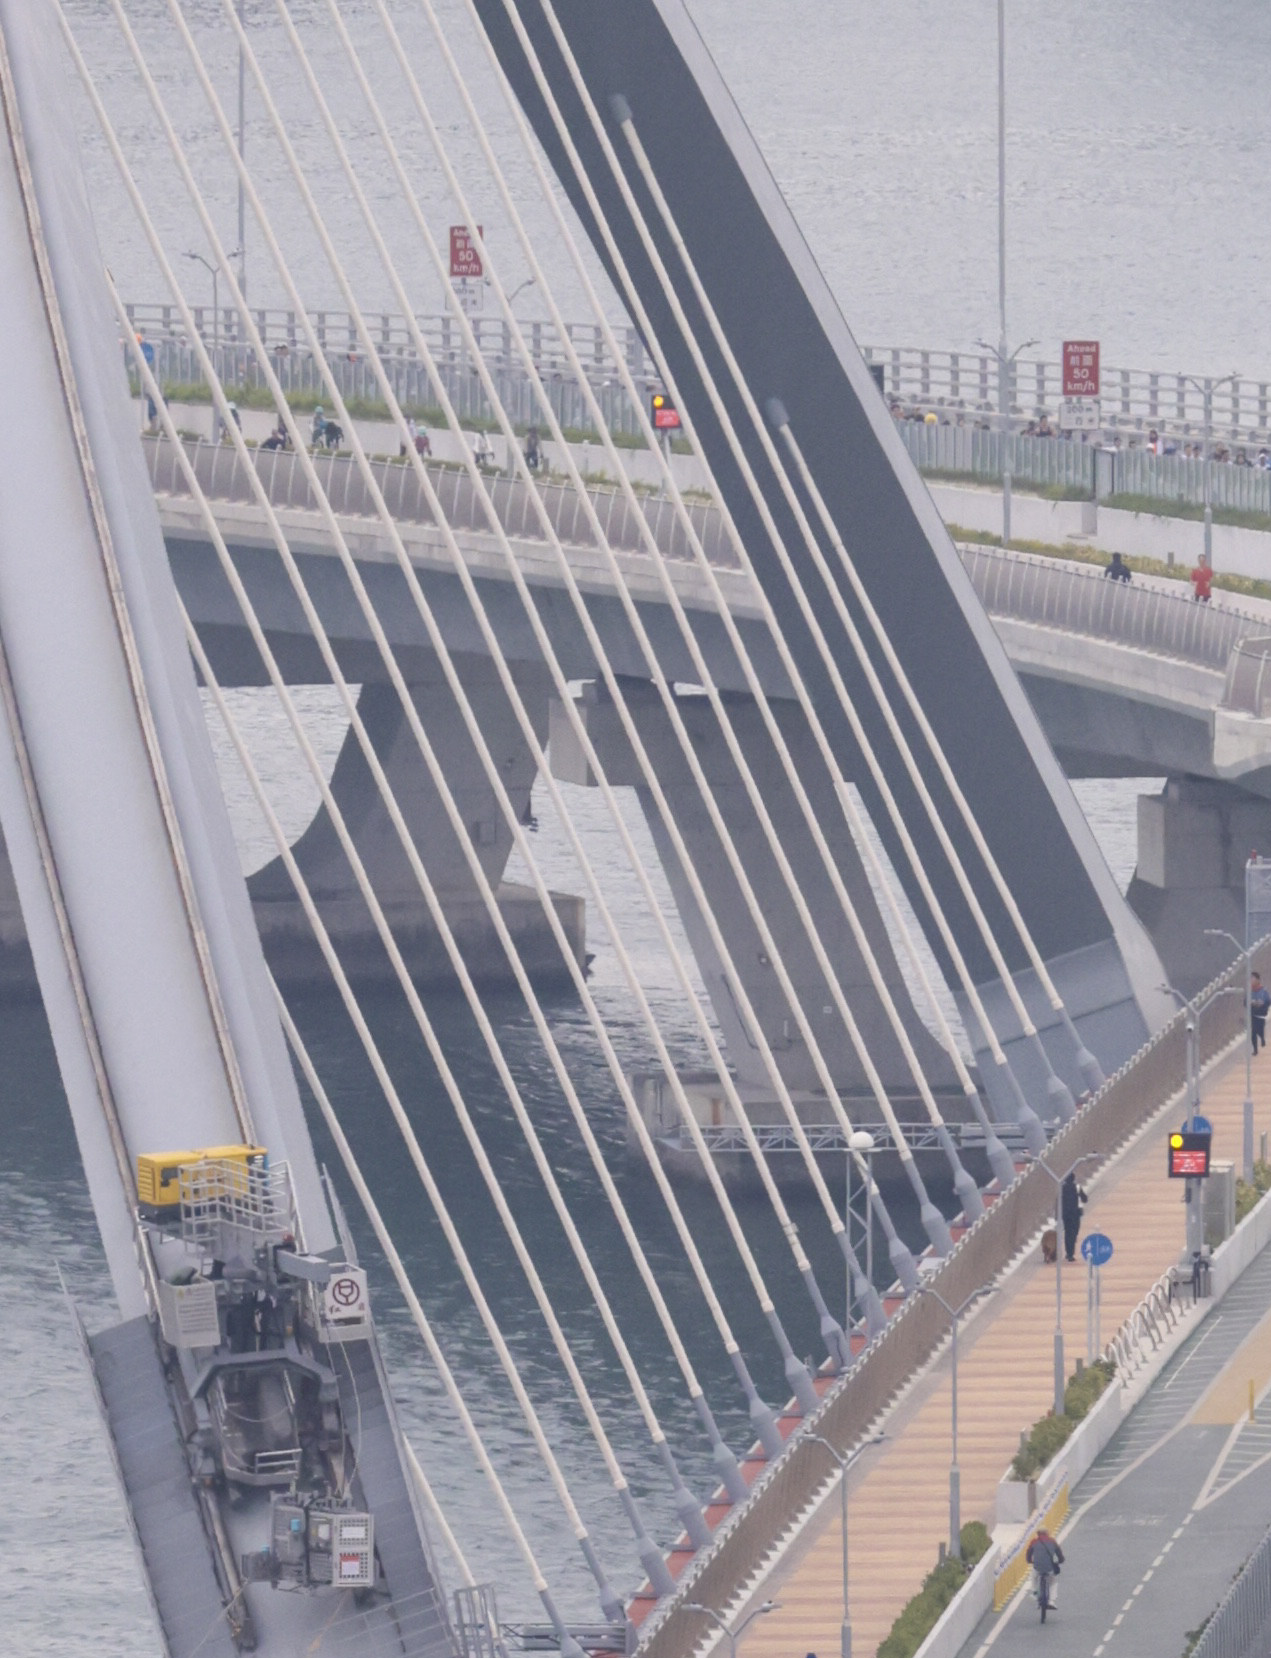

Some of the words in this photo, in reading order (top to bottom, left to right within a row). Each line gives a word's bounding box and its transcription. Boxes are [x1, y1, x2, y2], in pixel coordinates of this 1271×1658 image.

[459, 250, 474, 262] 50
[453, 263, 479, 274] km/h
[1067, 344, 1096, 353] Ahead
[1070, 354, 1093, 367] 前面
[1073, 368, 1089, 379] 50
[1067, 381, 1095, 392] km/h
